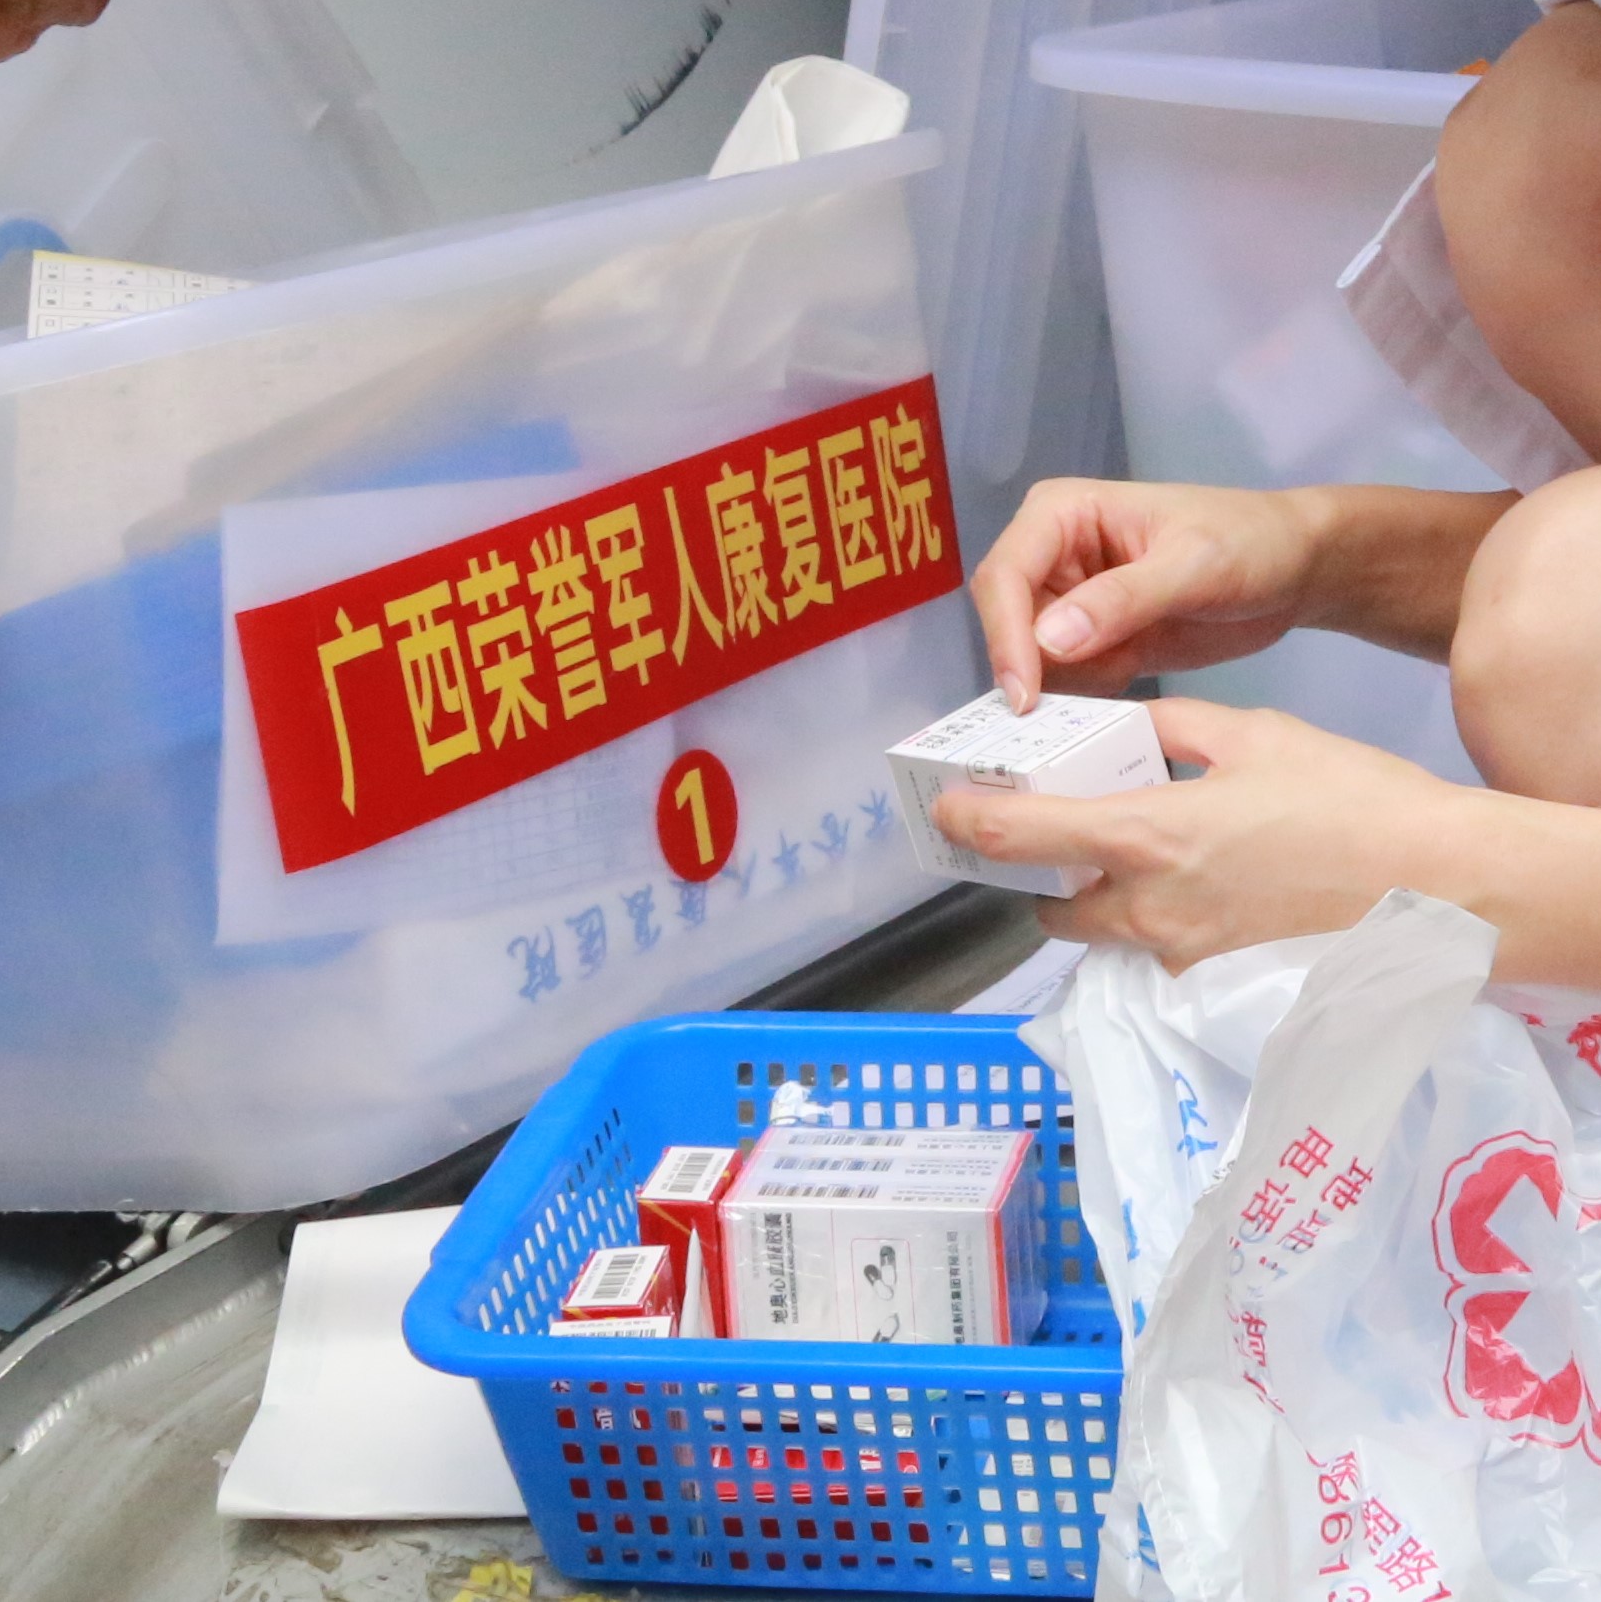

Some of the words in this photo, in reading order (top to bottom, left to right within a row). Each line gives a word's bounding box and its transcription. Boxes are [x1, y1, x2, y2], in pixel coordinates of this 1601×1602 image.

[316, 401, 944, 818] 广西荣誉军人康复医院
[674, 767, 715, 867] 1
